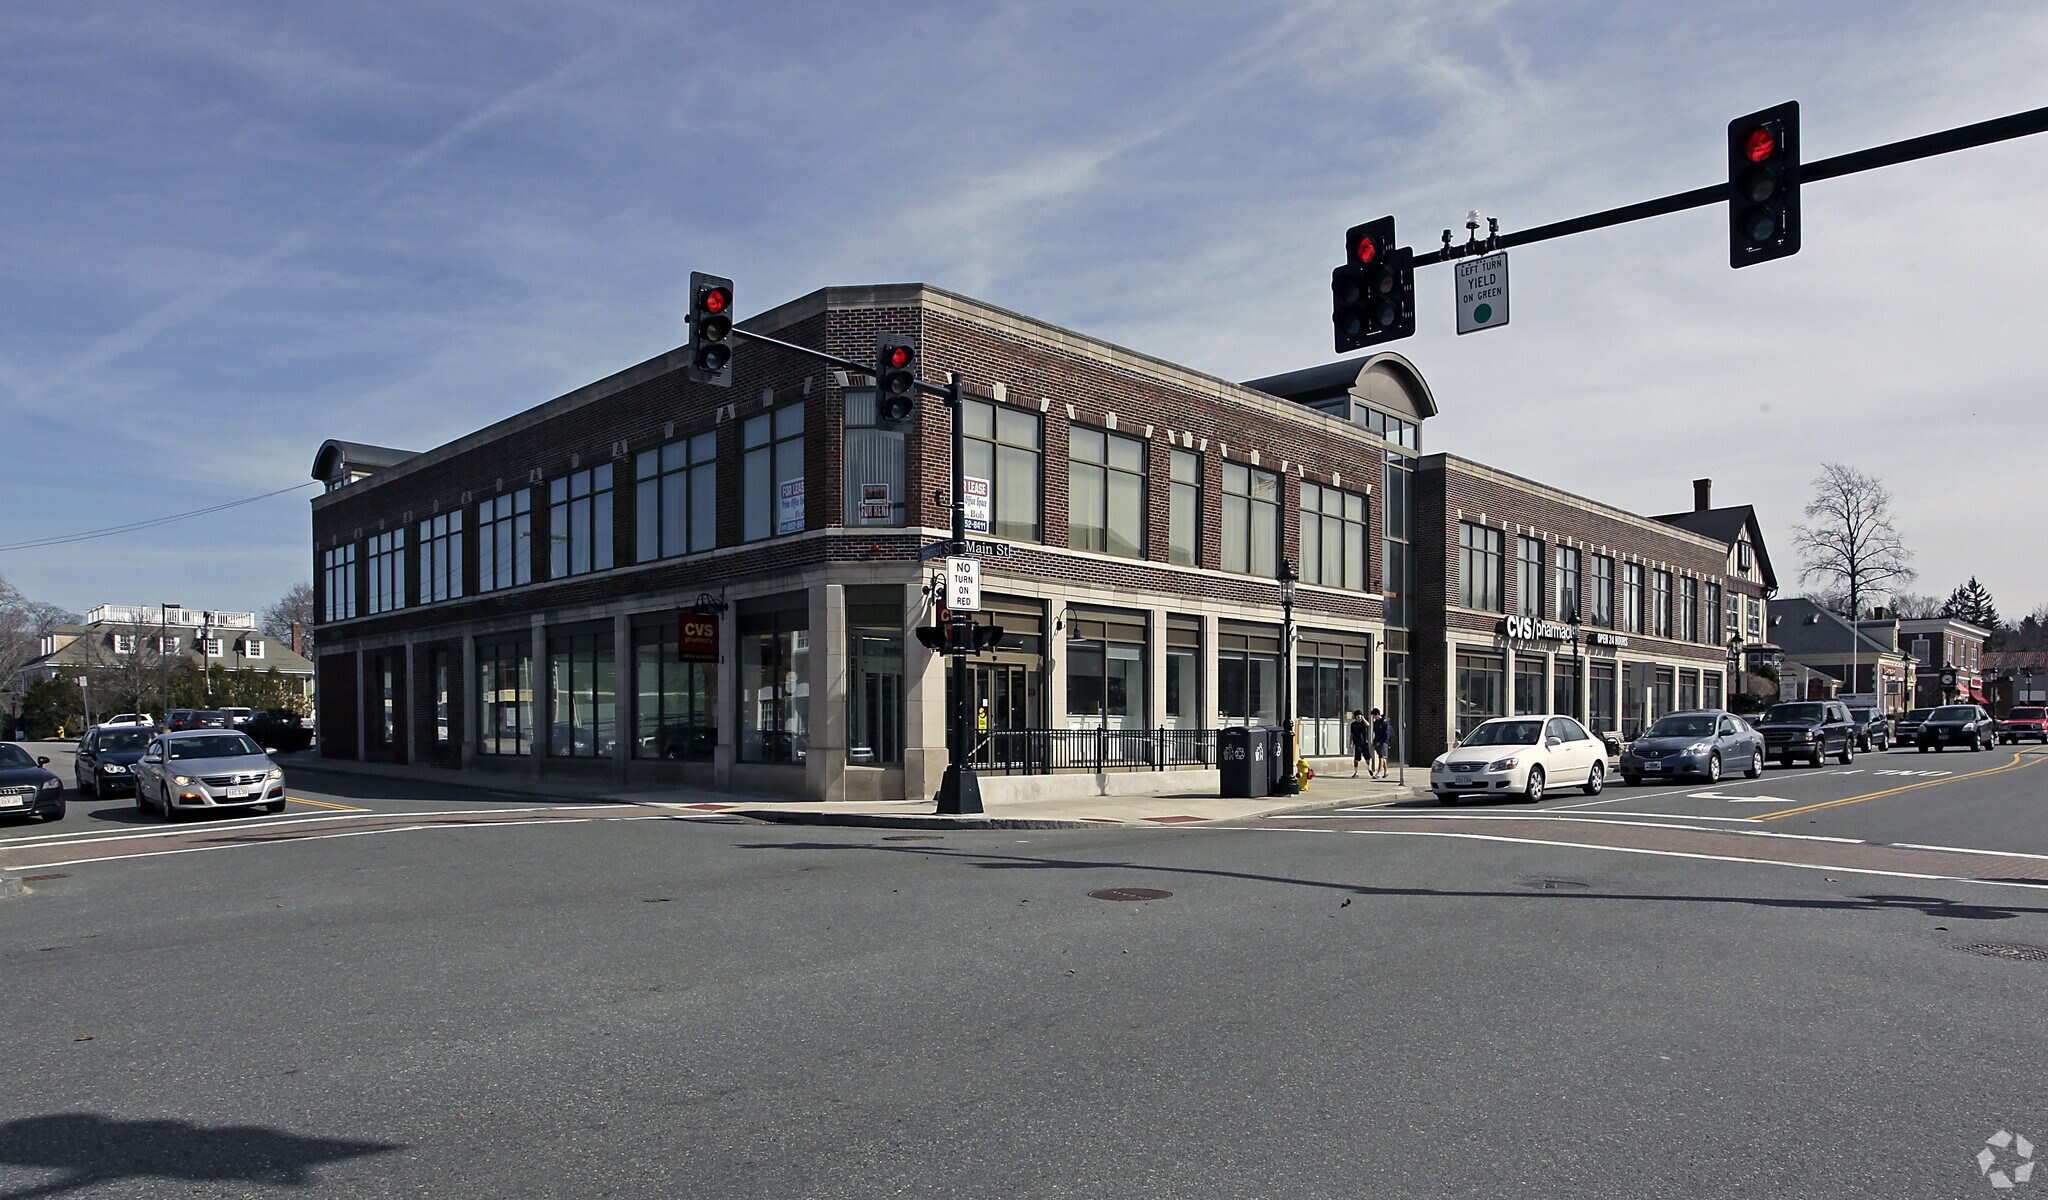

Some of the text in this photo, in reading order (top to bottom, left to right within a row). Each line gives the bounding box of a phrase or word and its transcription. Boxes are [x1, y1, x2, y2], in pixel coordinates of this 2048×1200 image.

[1461, 259, 1502, 277] LEFT TURN
[1468, 273, 1496, 290] YIELD
[1463, 287, 1502, 303] ON GREEN
[782, 481, 804, 498] FOR LEAS
[968, 481, 986, 496] LEASE
[795, 510, 804, 518] Bo
[970, 510, 985, 519] Bob
[964, 520, 986, 531] 52-8411
[965, 540, 1008, 556] Main St
[957, 563, 970, 573] NO
[954, 575, 973, 584] TURN
[959, 586, 969, 594] ON
[957, 597, 971, 606] RED
[685, 623, 713, 637] CVS
[1597, 633, 1628, 647] OPEN 24 HOURS
